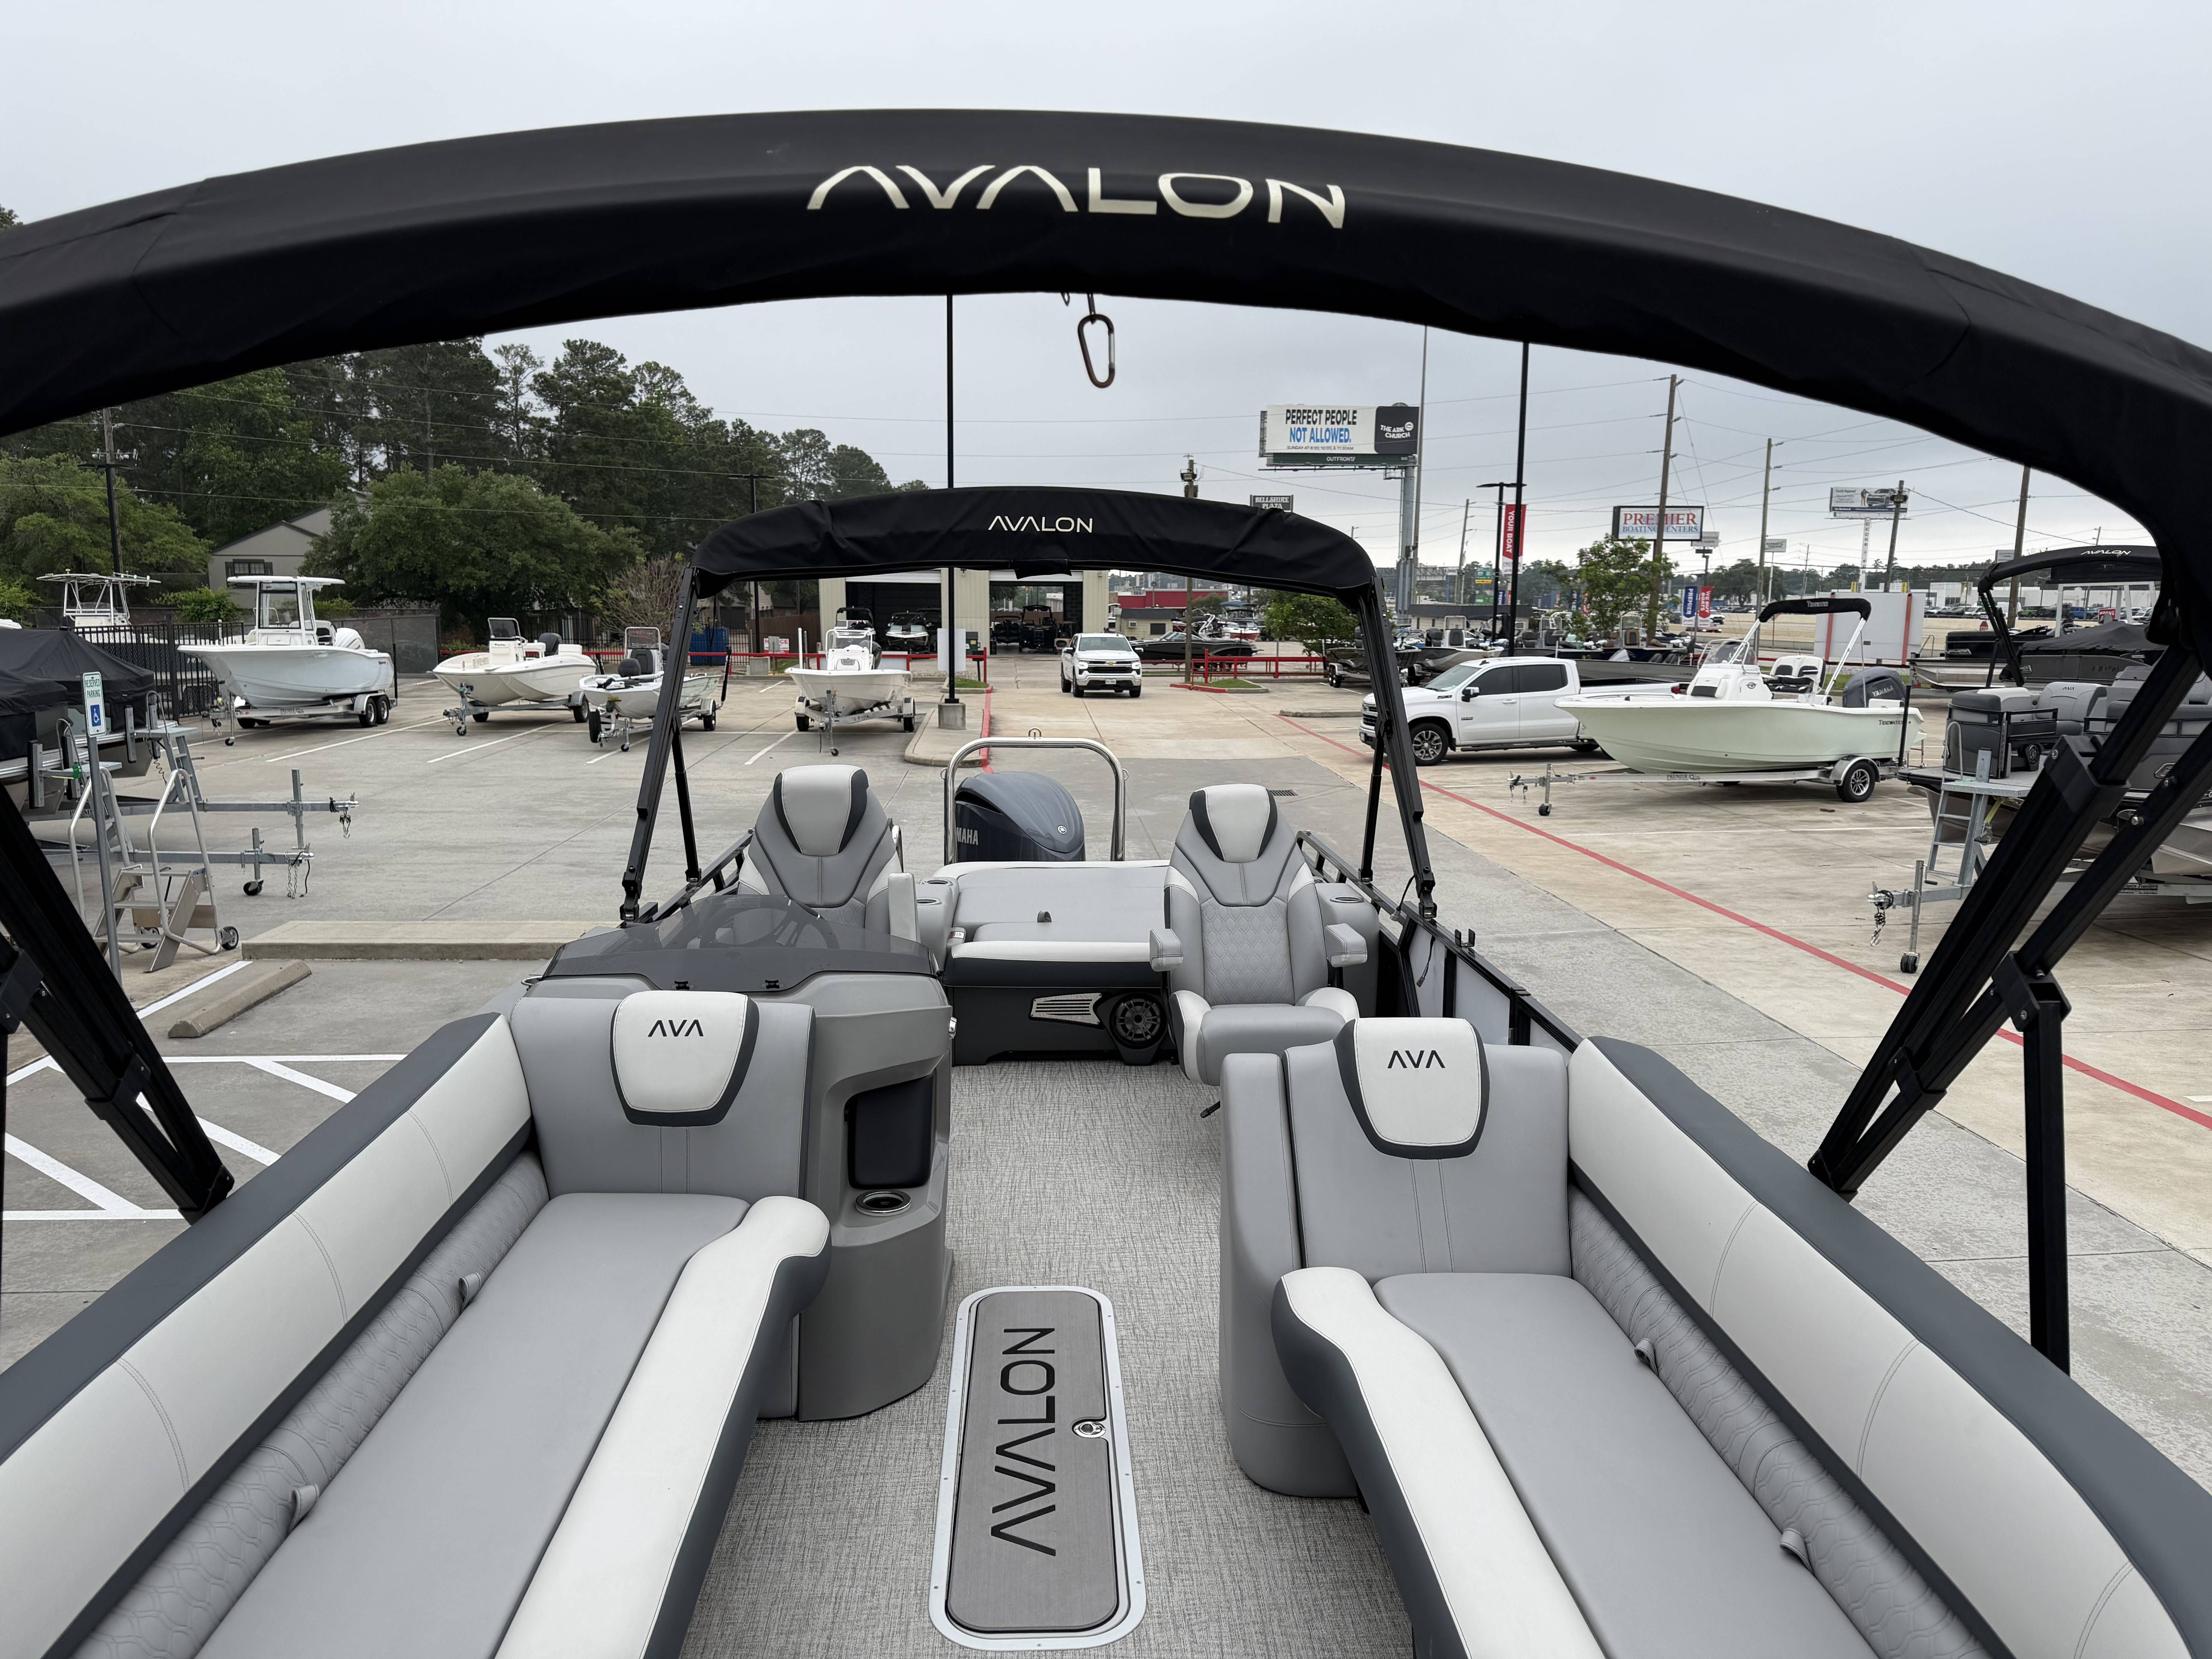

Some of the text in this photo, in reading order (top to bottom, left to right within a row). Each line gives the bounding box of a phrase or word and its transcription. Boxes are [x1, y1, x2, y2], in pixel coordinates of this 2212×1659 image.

[807, 165, 1345, 228] AVALON
[1286, 409, 1357, 425] PERFECT PEOPLE
[1290, 427, 1351, 443] NOT ALLOWED.
[988, 515, 1093, 533] AVALON
[1705, 591, 1711, 600] WE
[84, 679, 100, 688] RESERVED
[1872, 685, 1894, 697] YAMAHA
[87, 689, 100, 698] PARKING
[957, 827, 979, 845] MAHA
[647, 1019, 704, 1037] AVA
[1387, 1050, 1446, 1069] AVA
[991, 1328, 1056, 1557] AVALON
